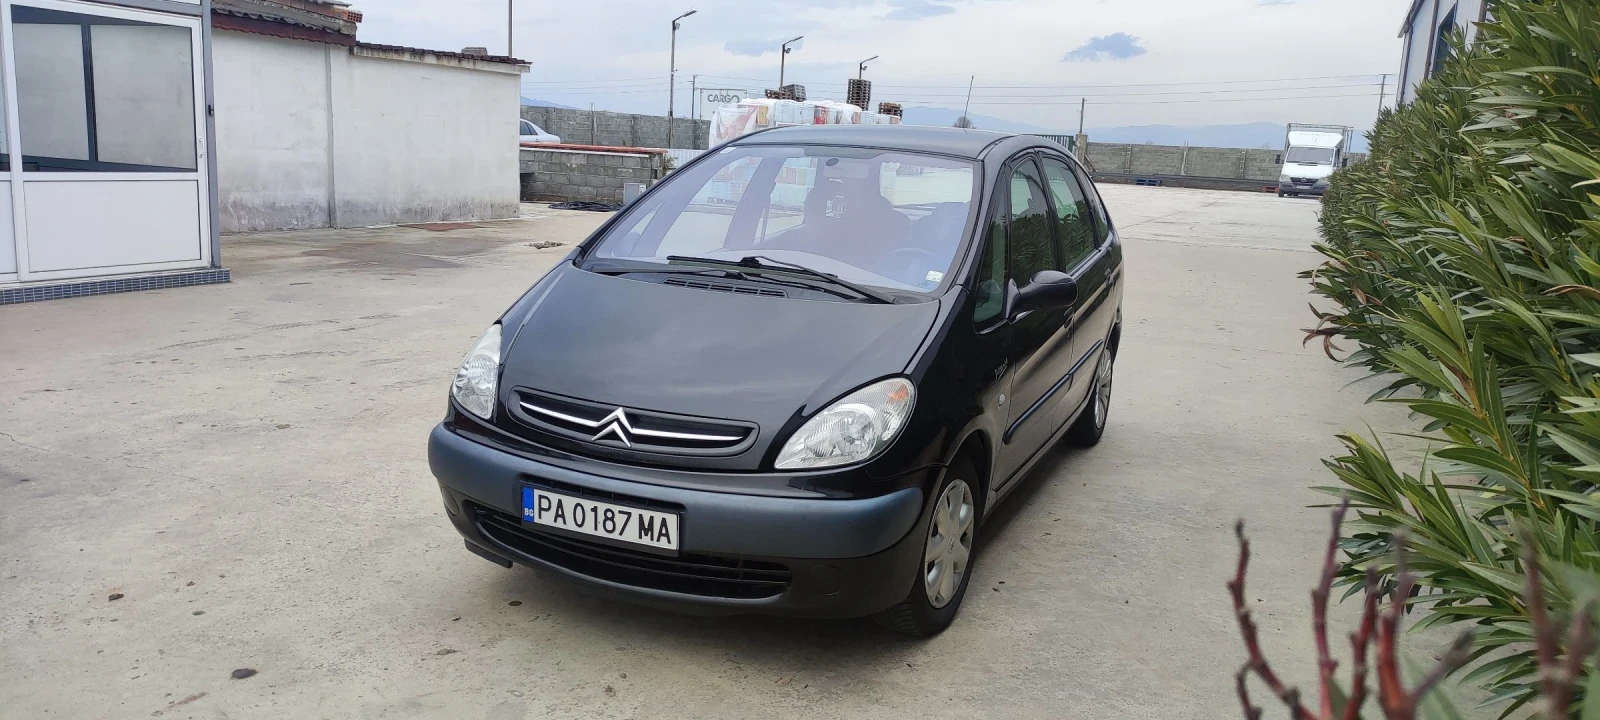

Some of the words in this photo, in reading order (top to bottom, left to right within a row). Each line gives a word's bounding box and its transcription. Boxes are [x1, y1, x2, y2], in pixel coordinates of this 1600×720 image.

[707, 94, 740, 103] CARGO
[524, 507, 534, 517] BG
[538, 494, 567, 525] PA
[572, 502, 632, 536] 0187
[638, 513, 672, 545] MA
